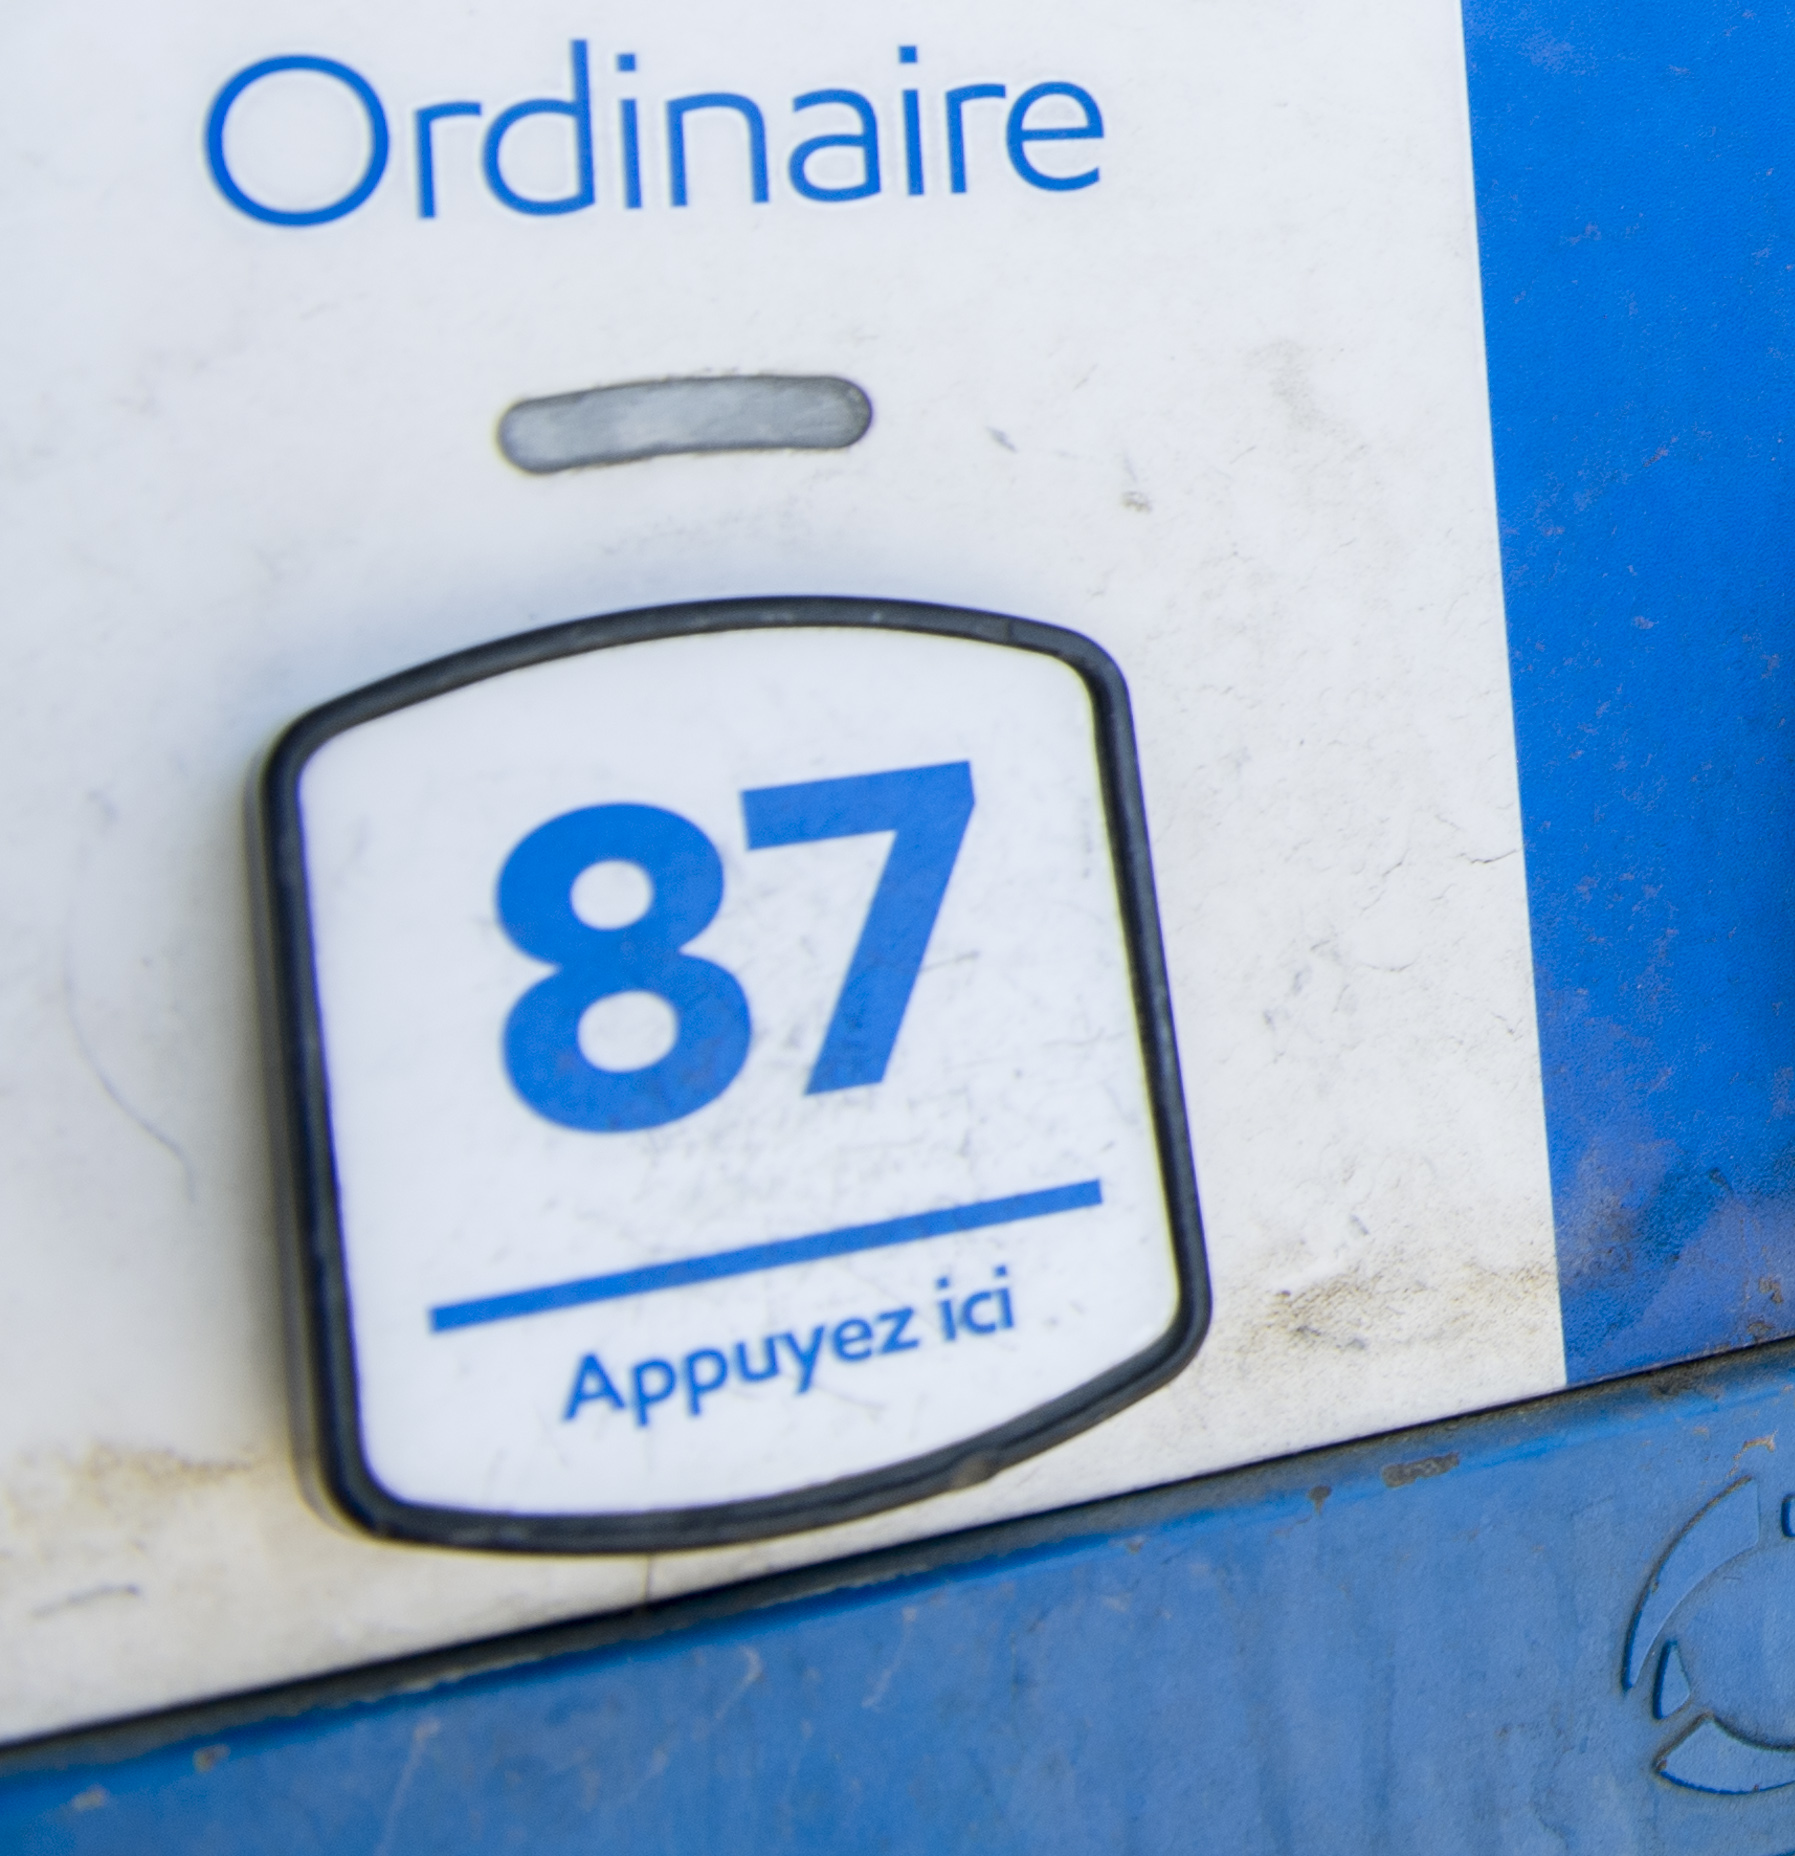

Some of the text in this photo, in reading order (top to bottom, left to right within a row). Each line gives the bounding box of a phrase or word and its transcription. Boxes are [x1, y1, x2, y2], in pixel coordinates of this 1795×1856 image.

[203, 38, 1105, 228] Ordinaire
[494, 759, 977, 1135] 87
[564, 1266, 1016, 1427] Appuyez ici
